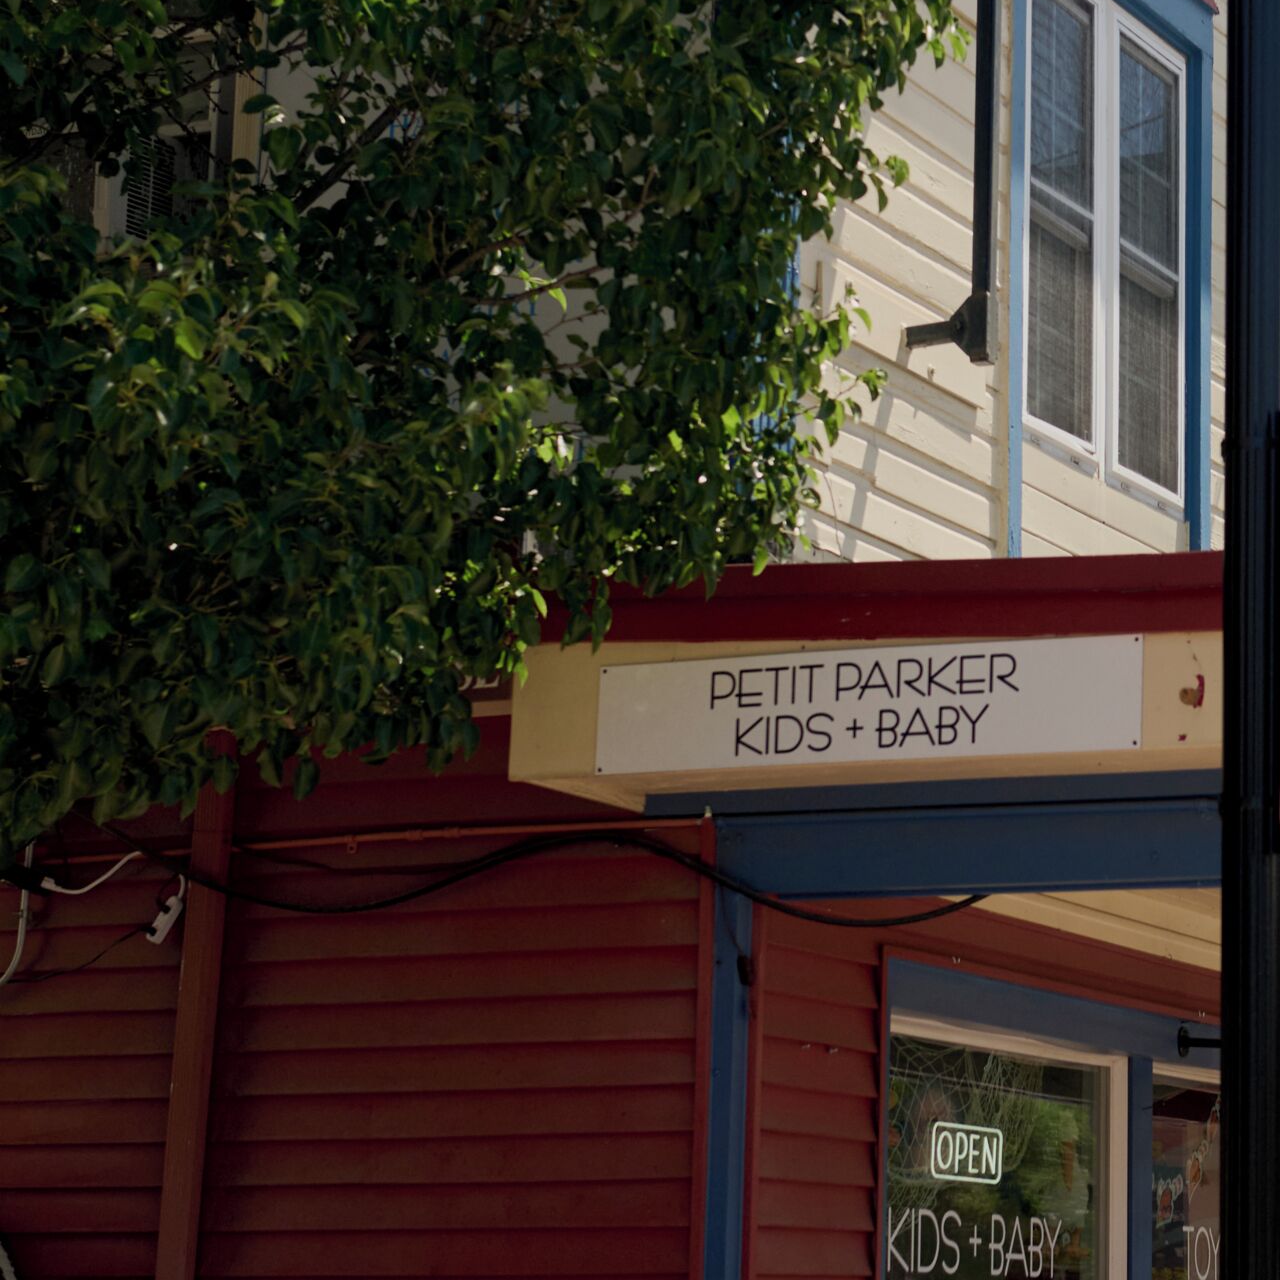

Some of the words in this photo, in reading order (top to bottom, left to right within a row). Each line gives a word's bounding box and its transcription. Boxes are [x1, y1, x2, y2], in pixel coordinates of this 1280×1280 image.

[710, 663, 826, 709] PETIT
[834, 652, 1020, 702] PARKER
[734, 711, 835, 757] KIDS
[876, 703, 990, 749] BABY
[936, 1131, 998, 1175] OPEN
[887, 1207, 961, 1276] KIDS
[988, 1212, 1062, 1279] BABY
